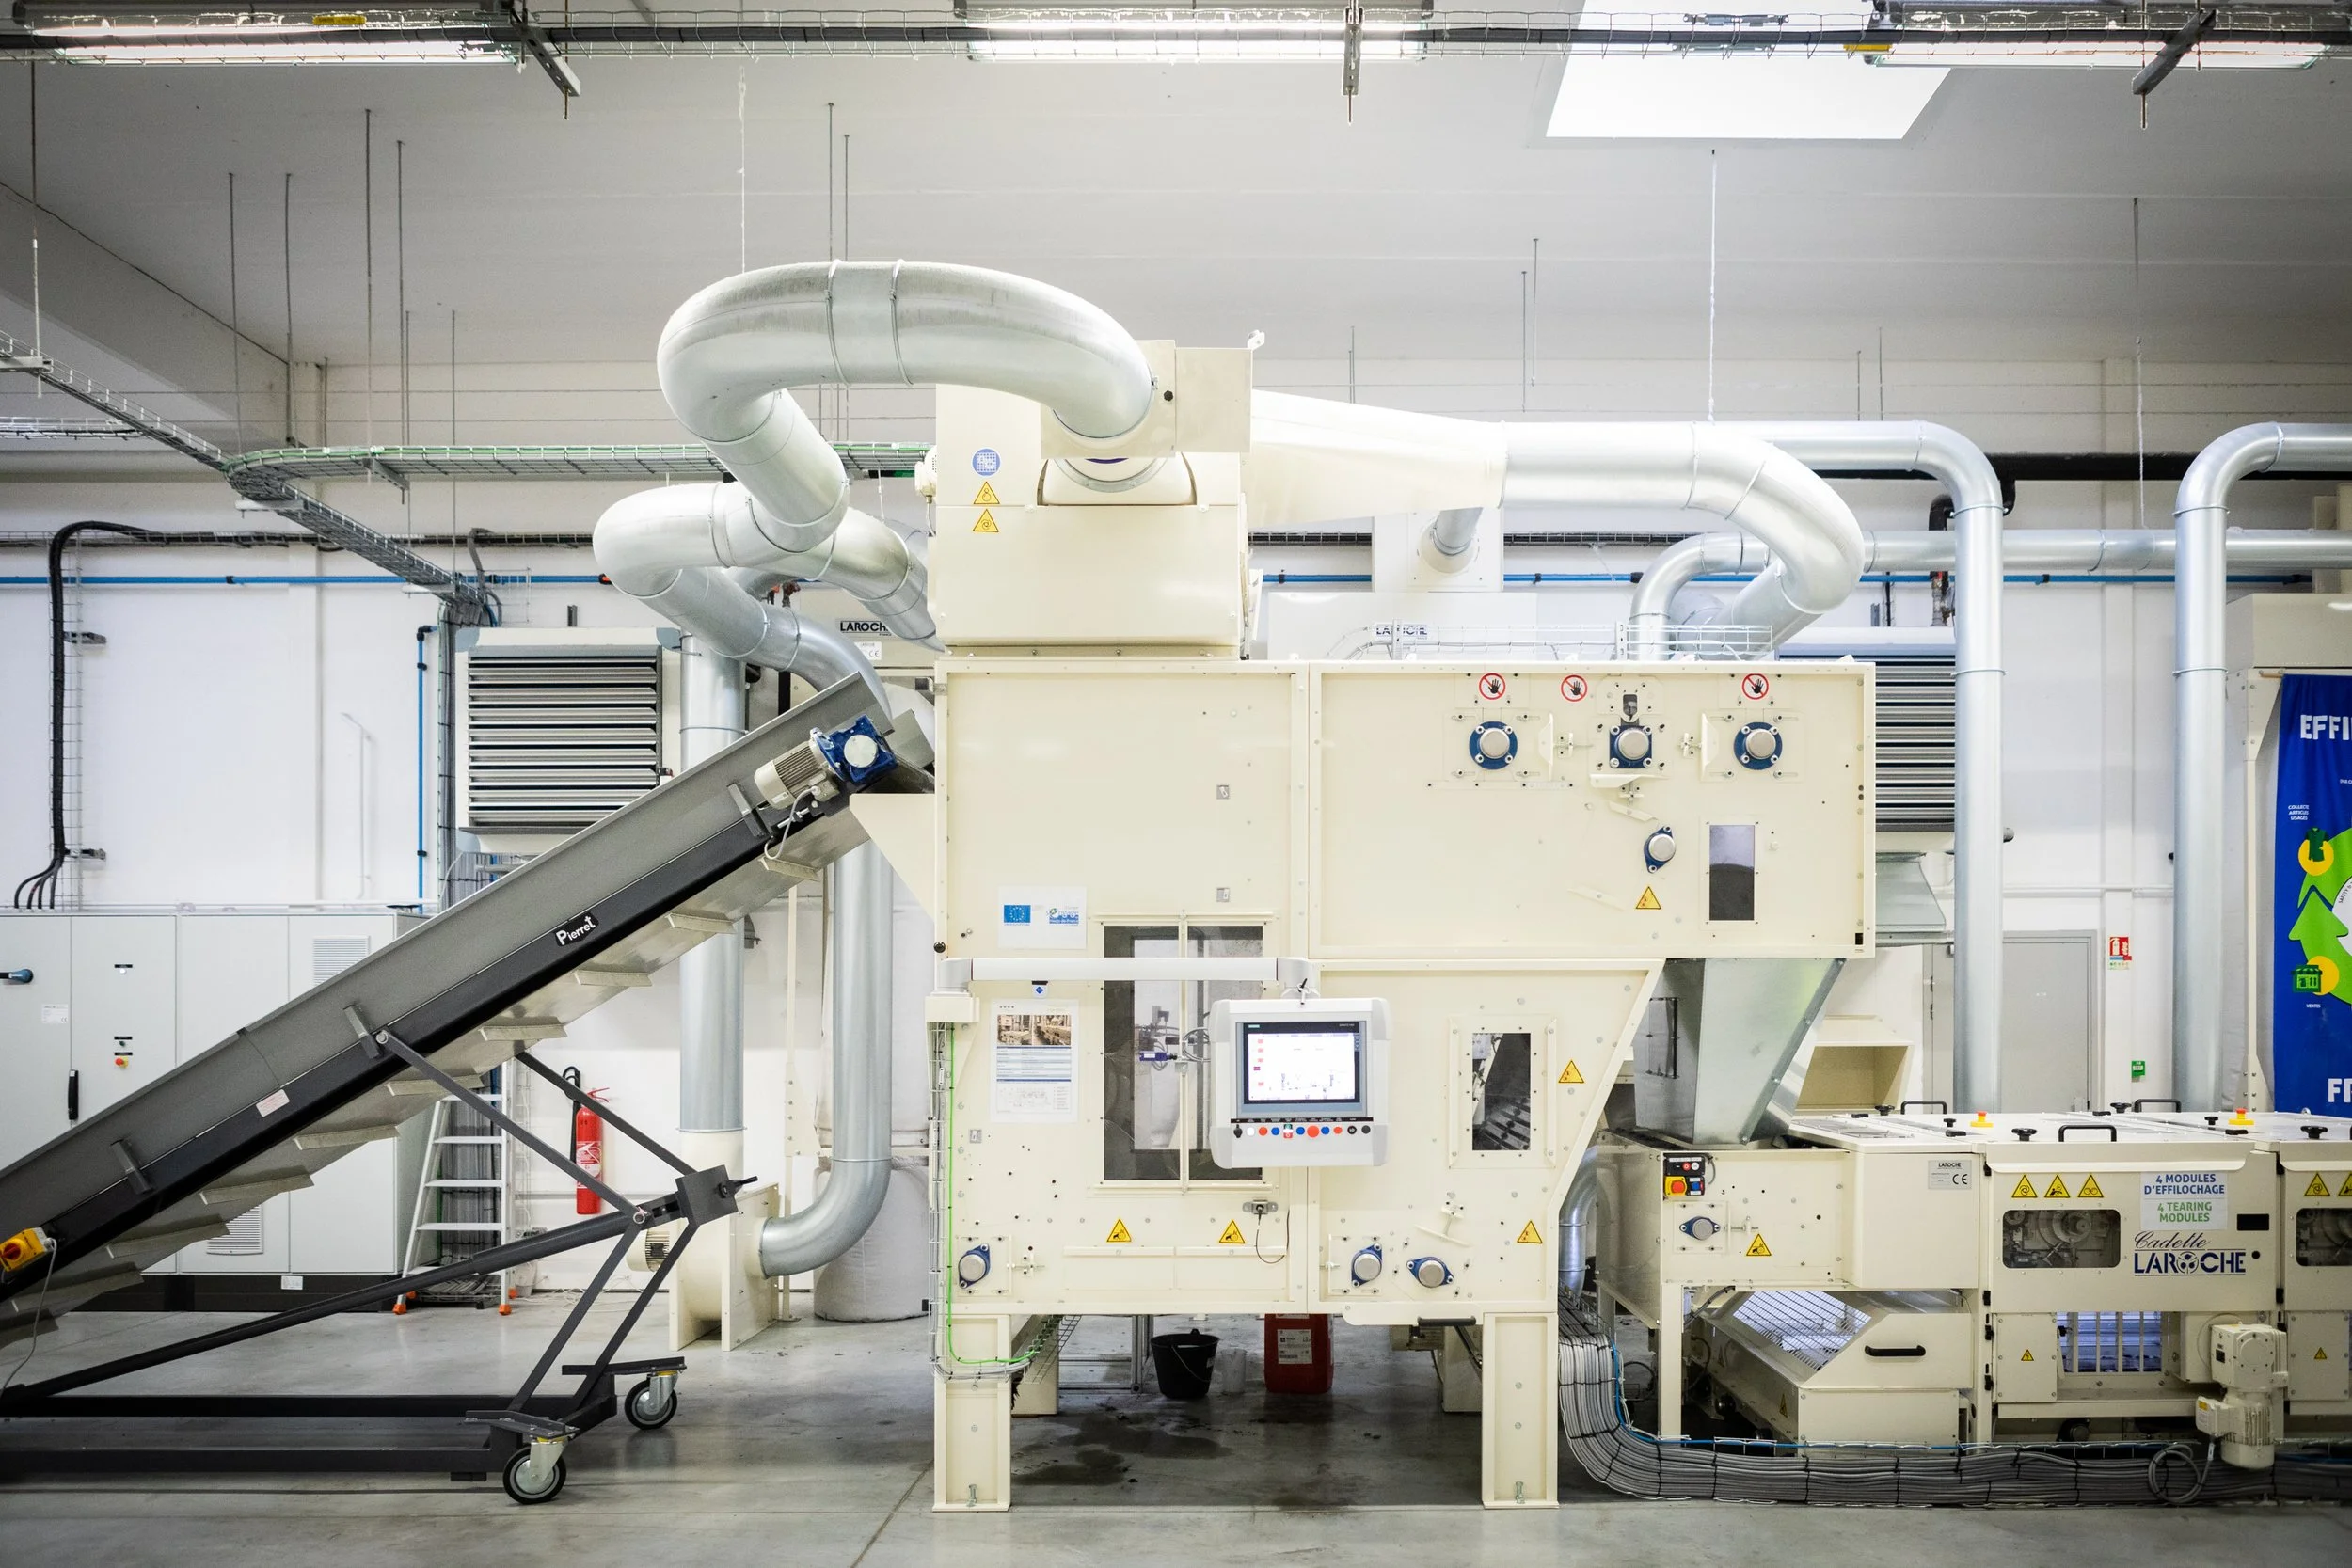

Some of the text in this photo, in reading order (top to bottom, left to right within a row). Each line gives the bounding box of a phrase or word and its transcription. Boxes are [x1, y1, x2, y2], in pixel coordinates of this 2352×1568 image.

[840, 622, 889, 631] LAROCH
[2300, 715, 2352, 740] EFFI
[556, 915, 596, 945] Pierret
[2155, 1173, 2217, 1184] 4 MODULES
[2144, 1184, 2225, 1195] D'EFFILOCHAGE
[2157, 1201, 2213, 1212] 4 TEARING
[2159, 1213, 2210, 1223] MODULES
[2134, 1230, 2211, 1249] Cadette
